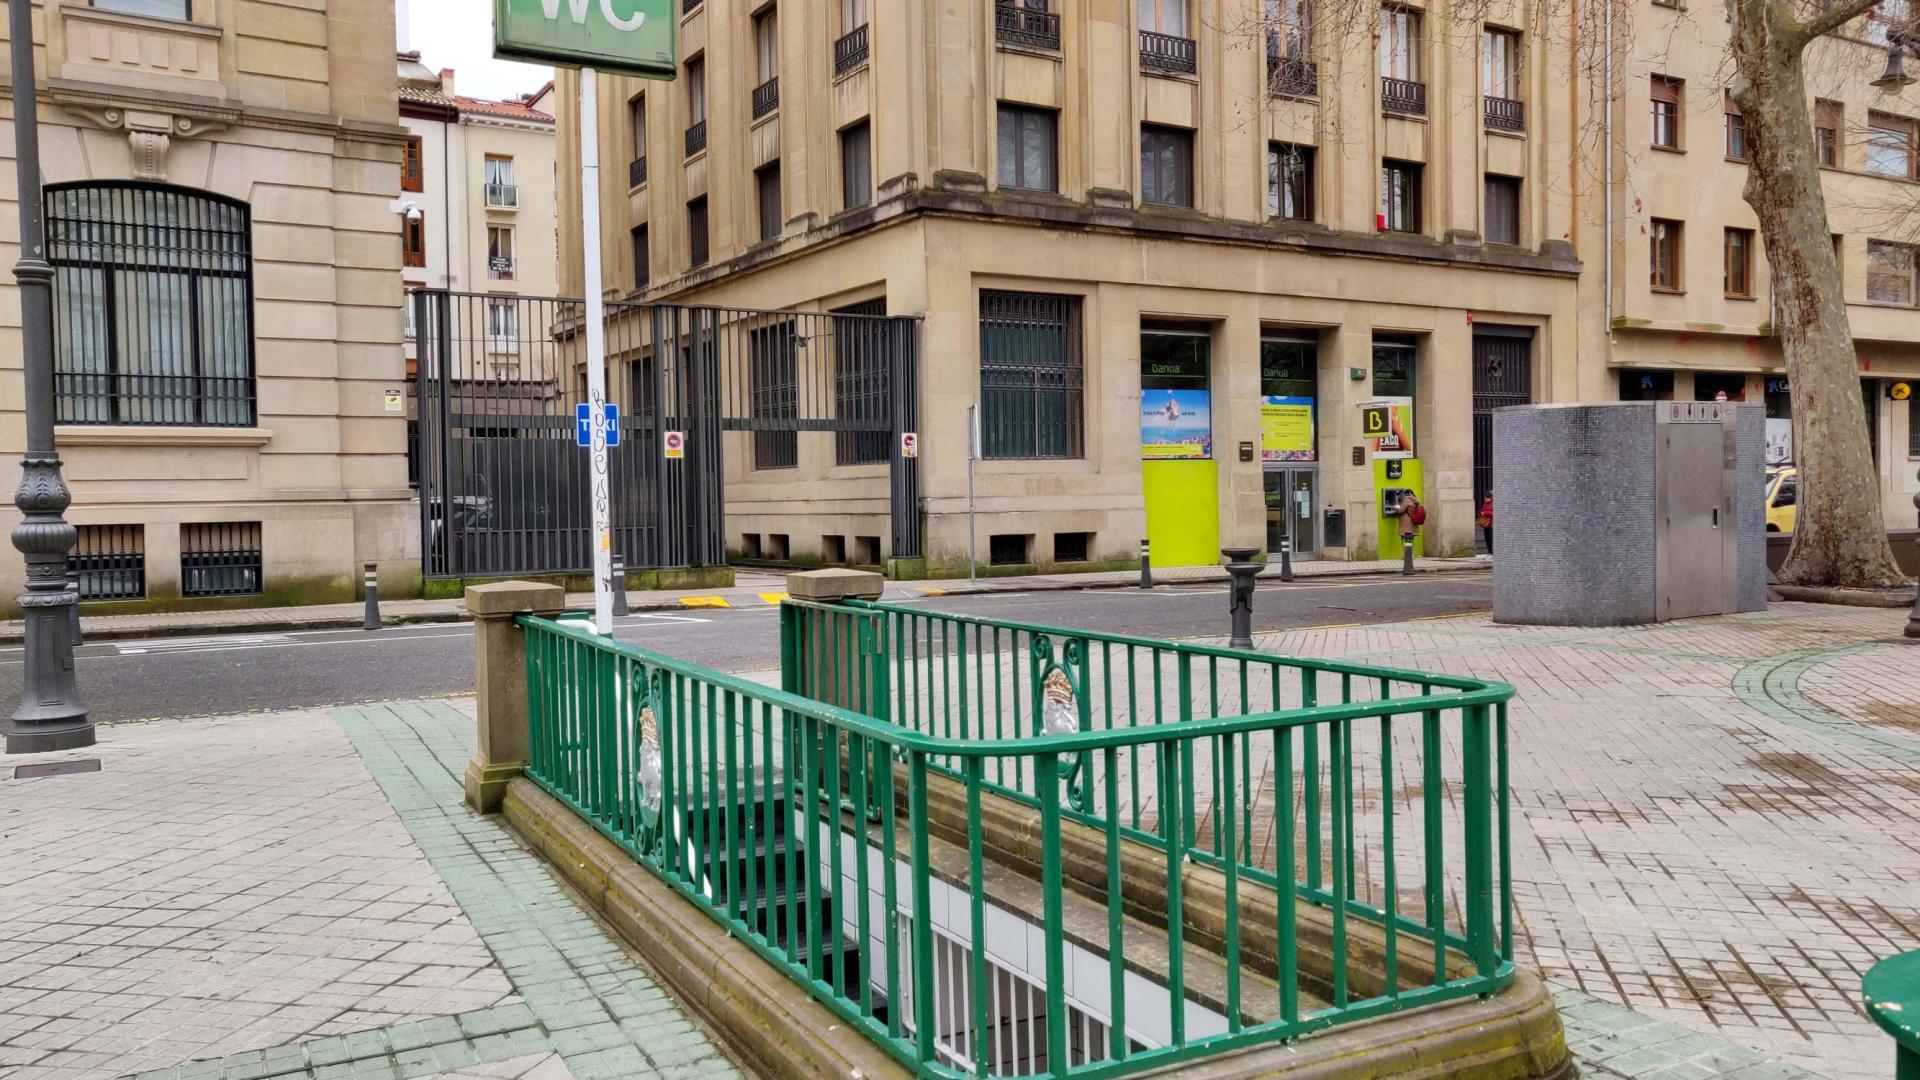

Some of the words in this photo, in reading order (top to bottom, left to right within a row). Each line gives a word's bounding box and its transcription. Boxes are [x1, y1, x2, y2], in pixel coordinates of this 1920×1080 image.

[1152, 363, 1180, 373] Bankia
[580, 418, 616, 432] TXI
[1370, 411, 1382, 430] B
